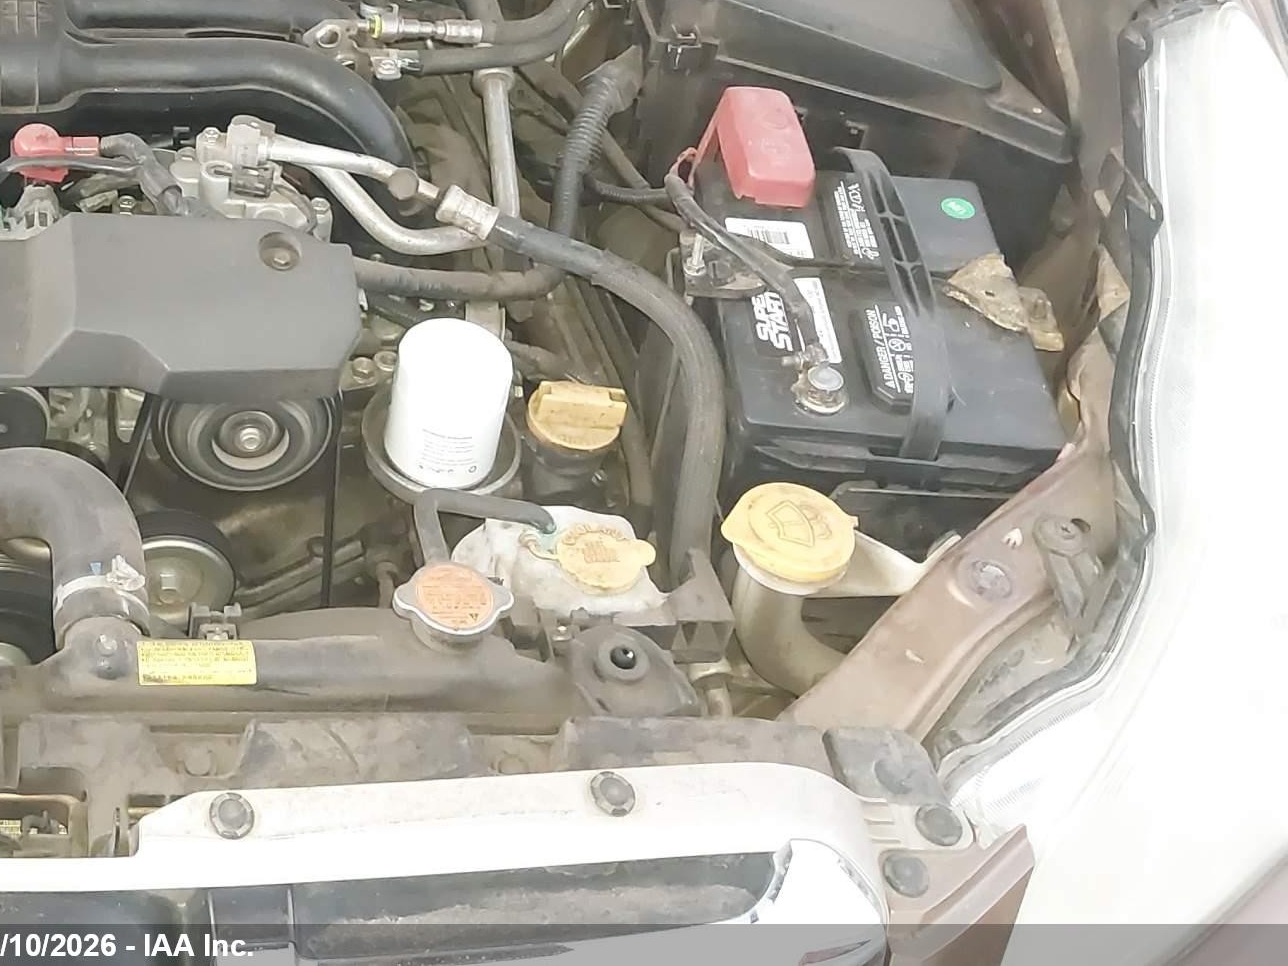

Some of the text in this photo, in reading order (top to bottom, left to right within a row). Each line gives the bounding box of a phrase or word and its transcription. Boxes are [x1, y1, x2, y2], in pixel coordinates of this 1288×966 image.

[751, 294, 769, 341] SUPE
[866, 309, 883, 340] POISON
[876, 345, 894, 380] DANGER
